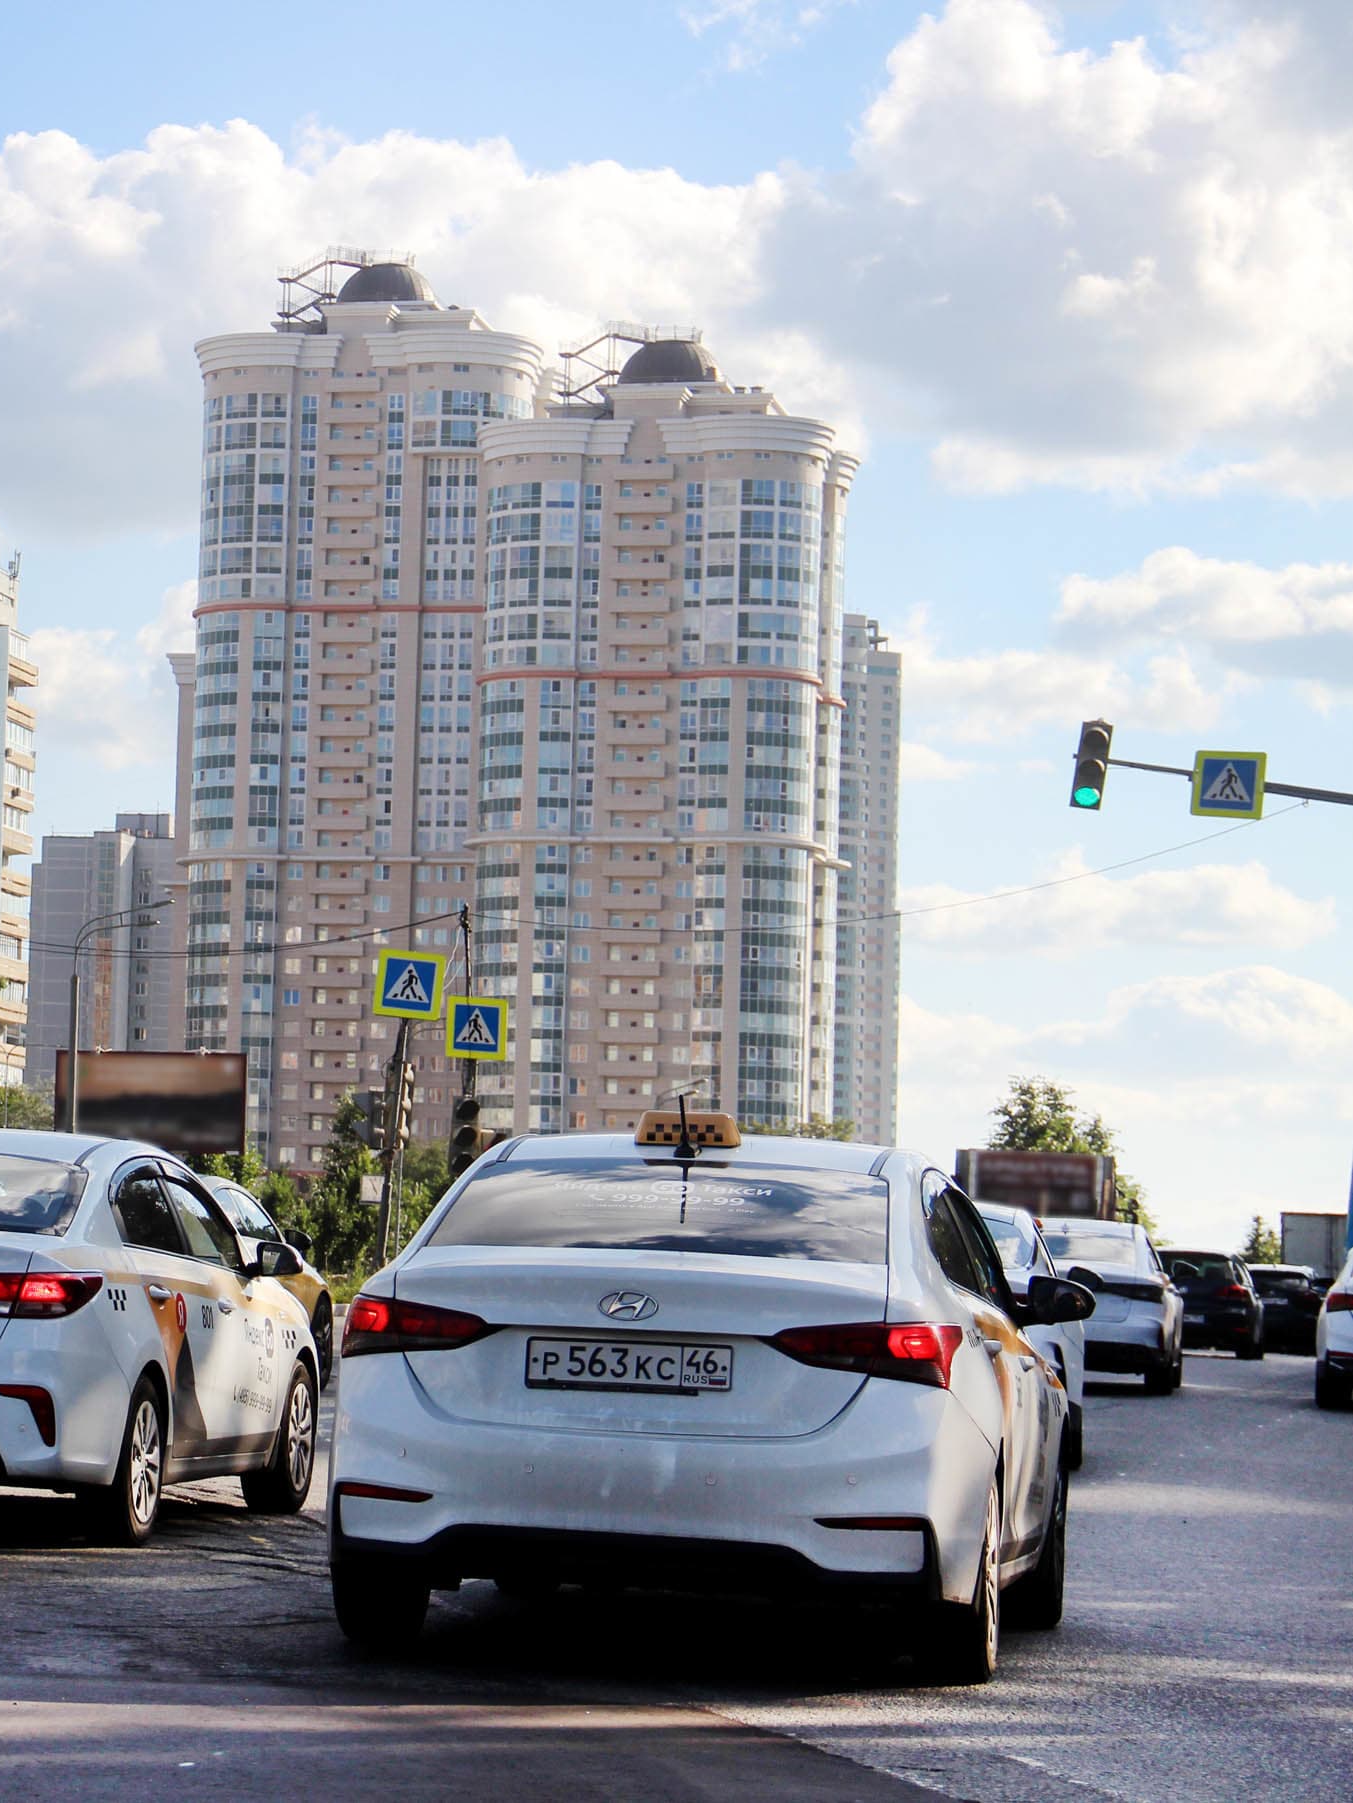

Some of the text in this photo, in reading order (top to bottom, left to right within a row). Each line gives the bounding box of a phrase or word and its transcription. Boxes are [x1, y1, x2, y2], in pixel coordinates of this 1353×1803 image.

[702, 1183, 773, 1196] Такси
[201, 1304, 214, 1329] 801
[686, 1350, 718, 1374] 46
[683, 1375, 708, 1384] RUS
